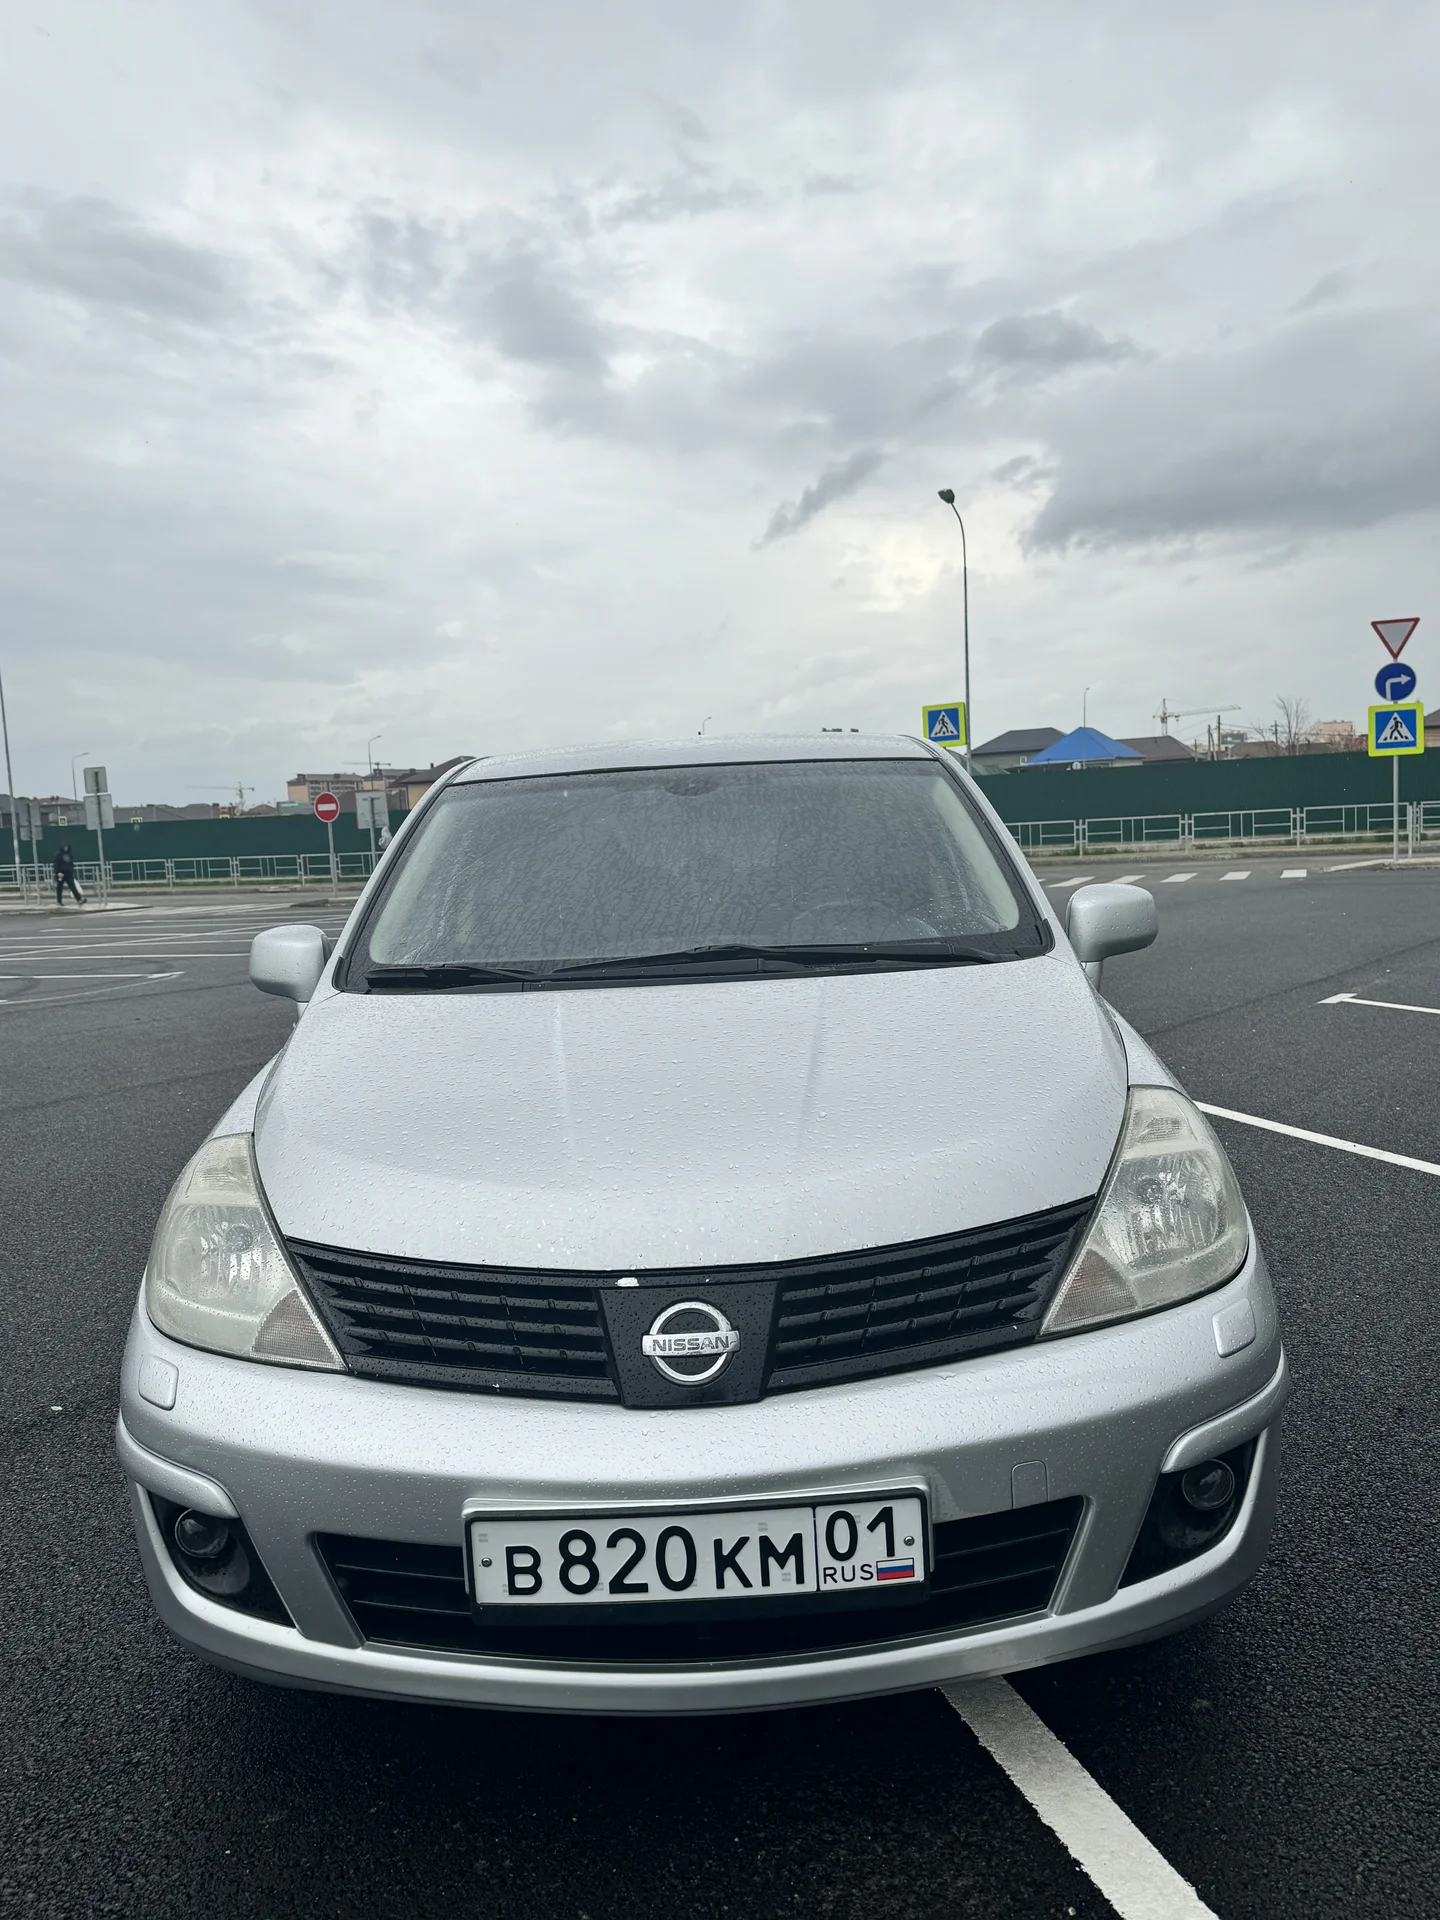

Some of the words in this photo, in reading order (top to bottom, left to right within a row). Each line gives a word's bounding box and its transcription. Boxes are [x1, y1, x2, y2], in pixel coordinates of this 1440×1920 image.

[652, 1335, 729, 1352] NISSAN
[825, 1506, 895, 1562] 01
[823, 1564, 874, 1584] RUS
